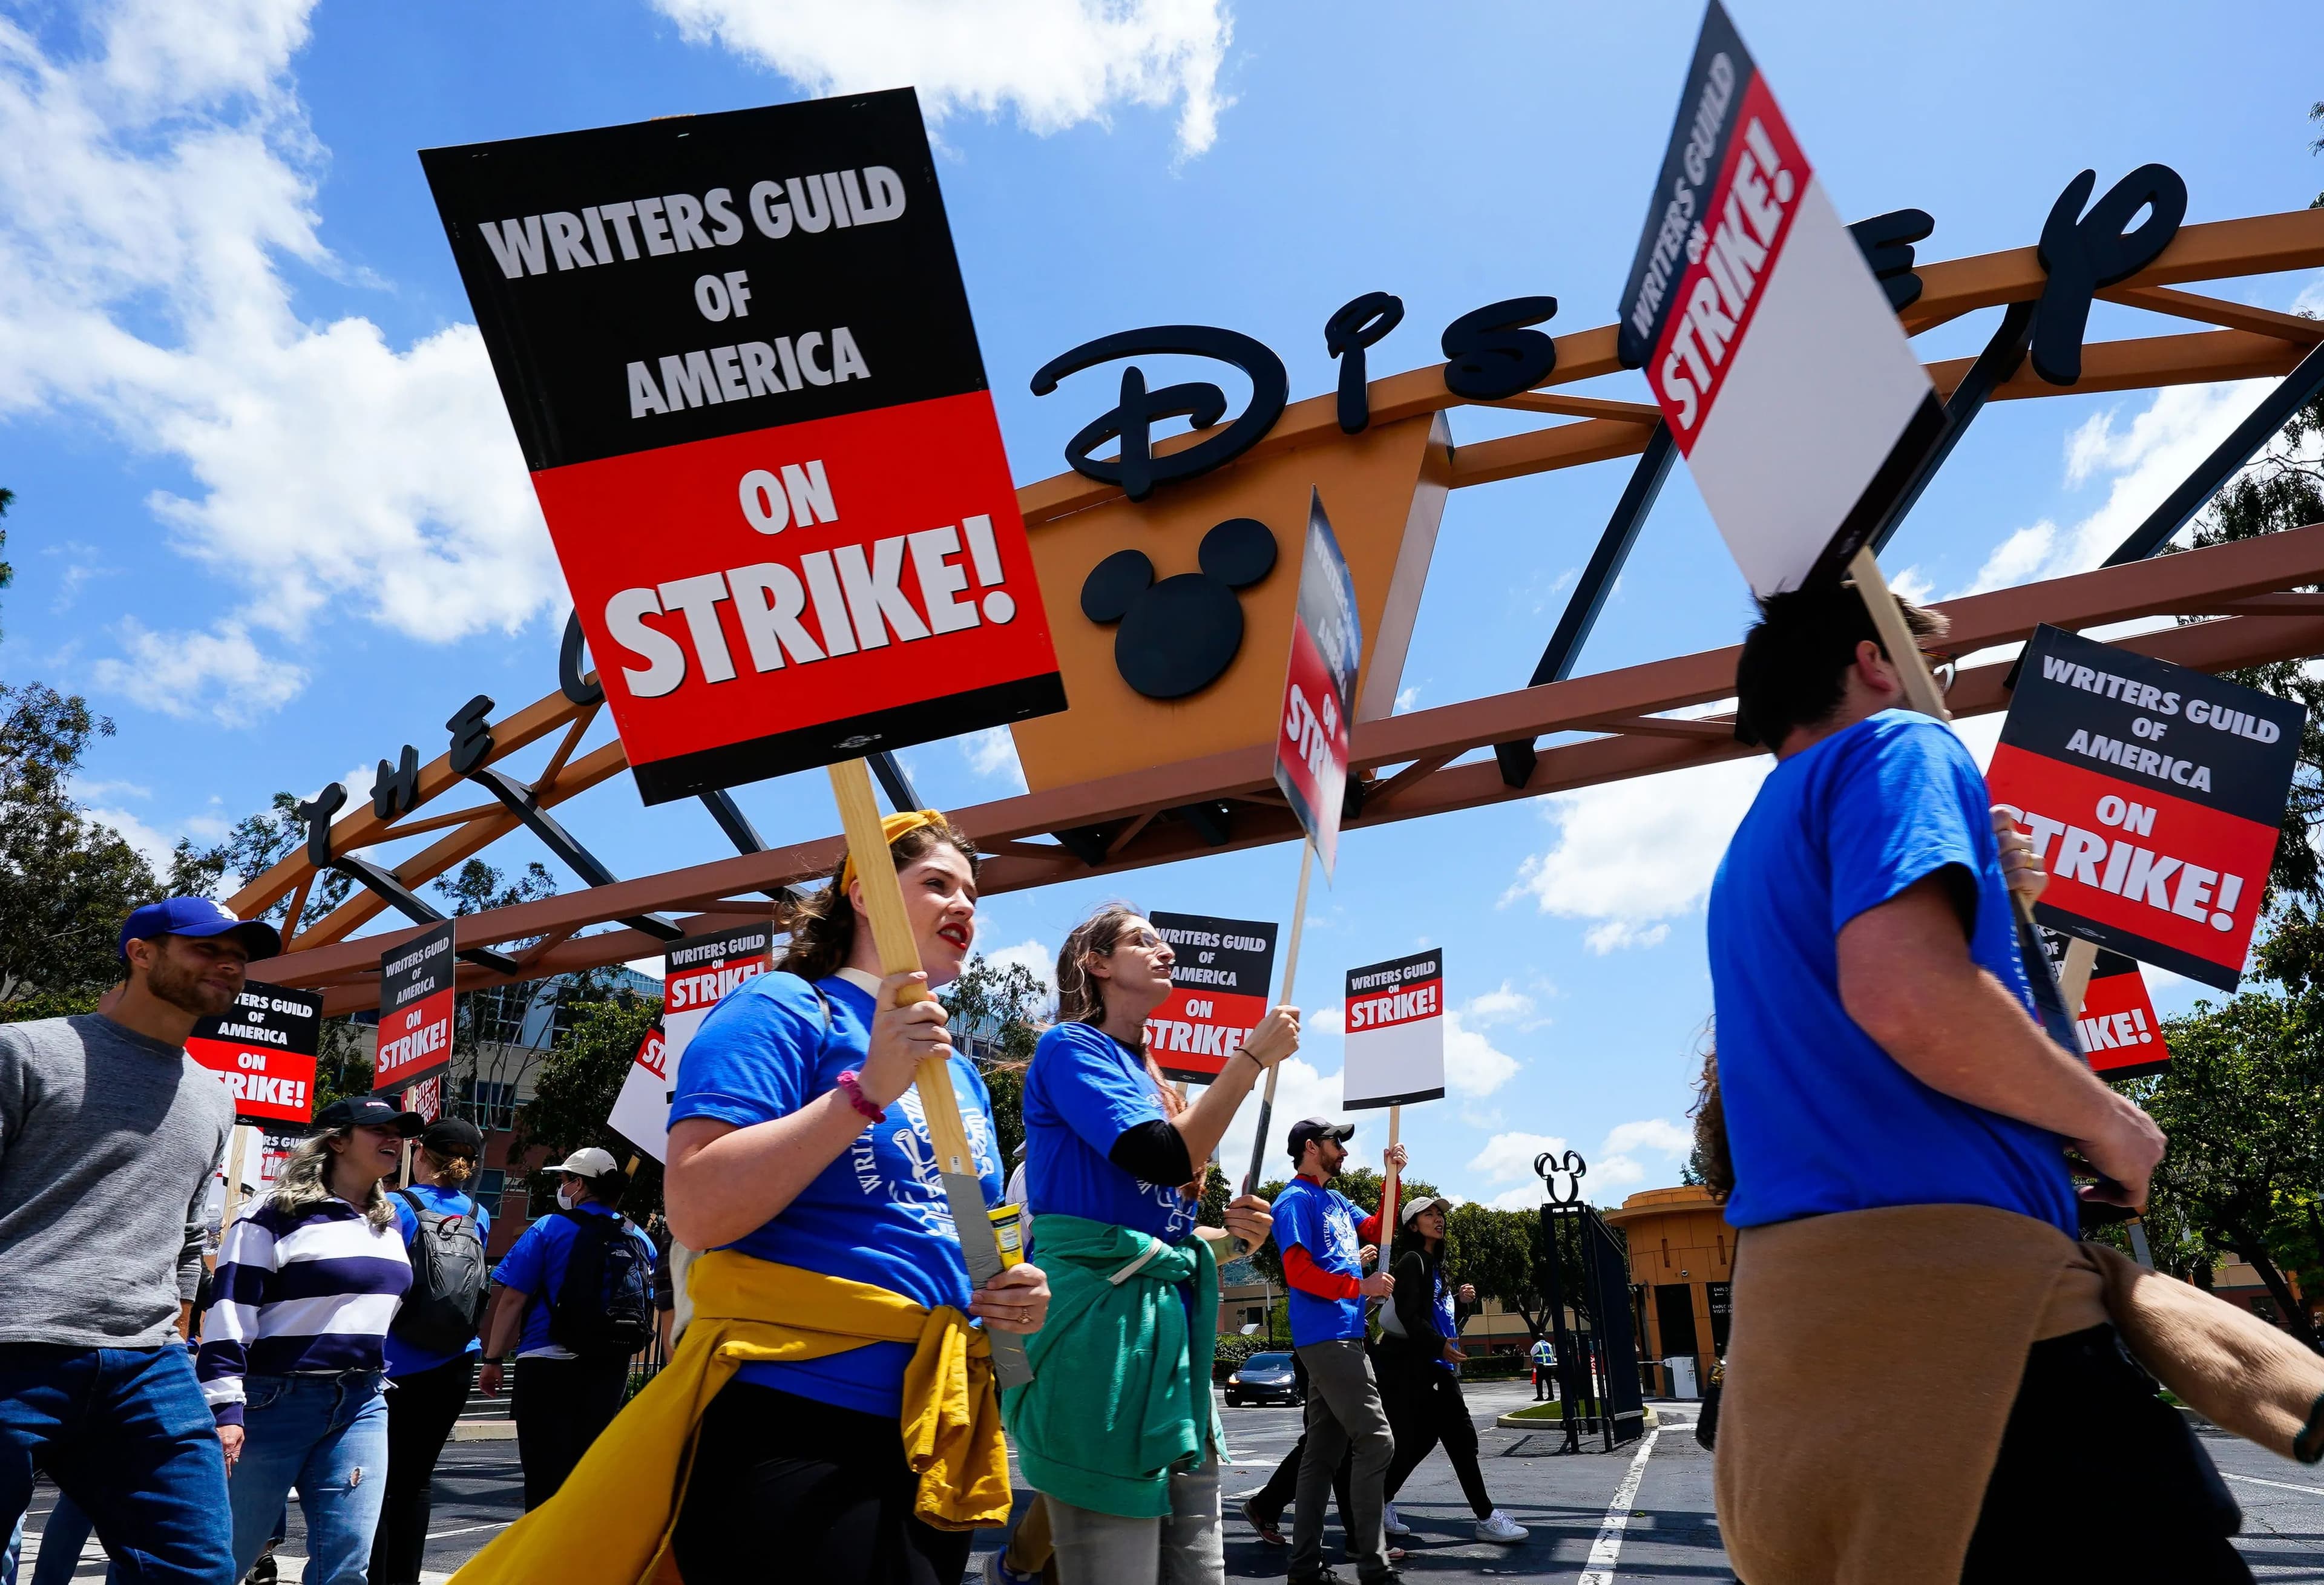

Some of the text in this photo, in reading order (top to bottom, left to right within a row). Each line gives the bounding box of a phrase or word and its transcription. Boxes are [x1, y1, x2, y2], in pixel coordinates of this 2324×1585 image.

[1632, 52, 1735, 339] WRITERS GUILD
[479, 166, 907, 280] WRITERS GUILD
[1686, 220, 1709, 264] ON
[1662, 116, 1795, 430] STRIKE!
[694, 270, 752, 321] OF
[626, 327, 871, 419] AMERICA
[738, 459, 838, 535] ON
[605, 514, 1016, 698] STRIKE!
[2043, 656, 2280, 744] WRITERS GUILD
[2131, 717, 2167, 742] OF
[2066, 729, 2211, 793] AMERICA
[300, 695, 494, 868] THE
[2095, 795, 2157, 838] ON
[386, 937, 449, 977] WRITERS GUILD
[672, 934, 765, 965] WRITERS GUILD
[1198, 951, 1215, 964] OF
[1223, 935, 1266, 952] GUILD
[412, 966, 421, 980] OF
[712, 959, 724, 969] ON
[1170, 966, 1237, 986] AMERICA
[1351, 961, 1436, 990] WRITERS GUILD
[234, 993, 312, 1017] TERS GUILD
[396, 976, 435, 1005] AMERICA
[1351, 985, 1437, 1028] STRIKE!
[1388, 984, 1399, 994] ON
[248, 1011, 264, 1023] OF
[406, 1009, 422, 1029] ON
[1186, 999, 1213, 1019] ON
[218, 1022, 287, 1045] AMERICA
[378, 1018, 447, 1072] STRIKE!
[2075, 1008, 2152, 1052] IKE!
[238, 1052, 266, 1071] ON
